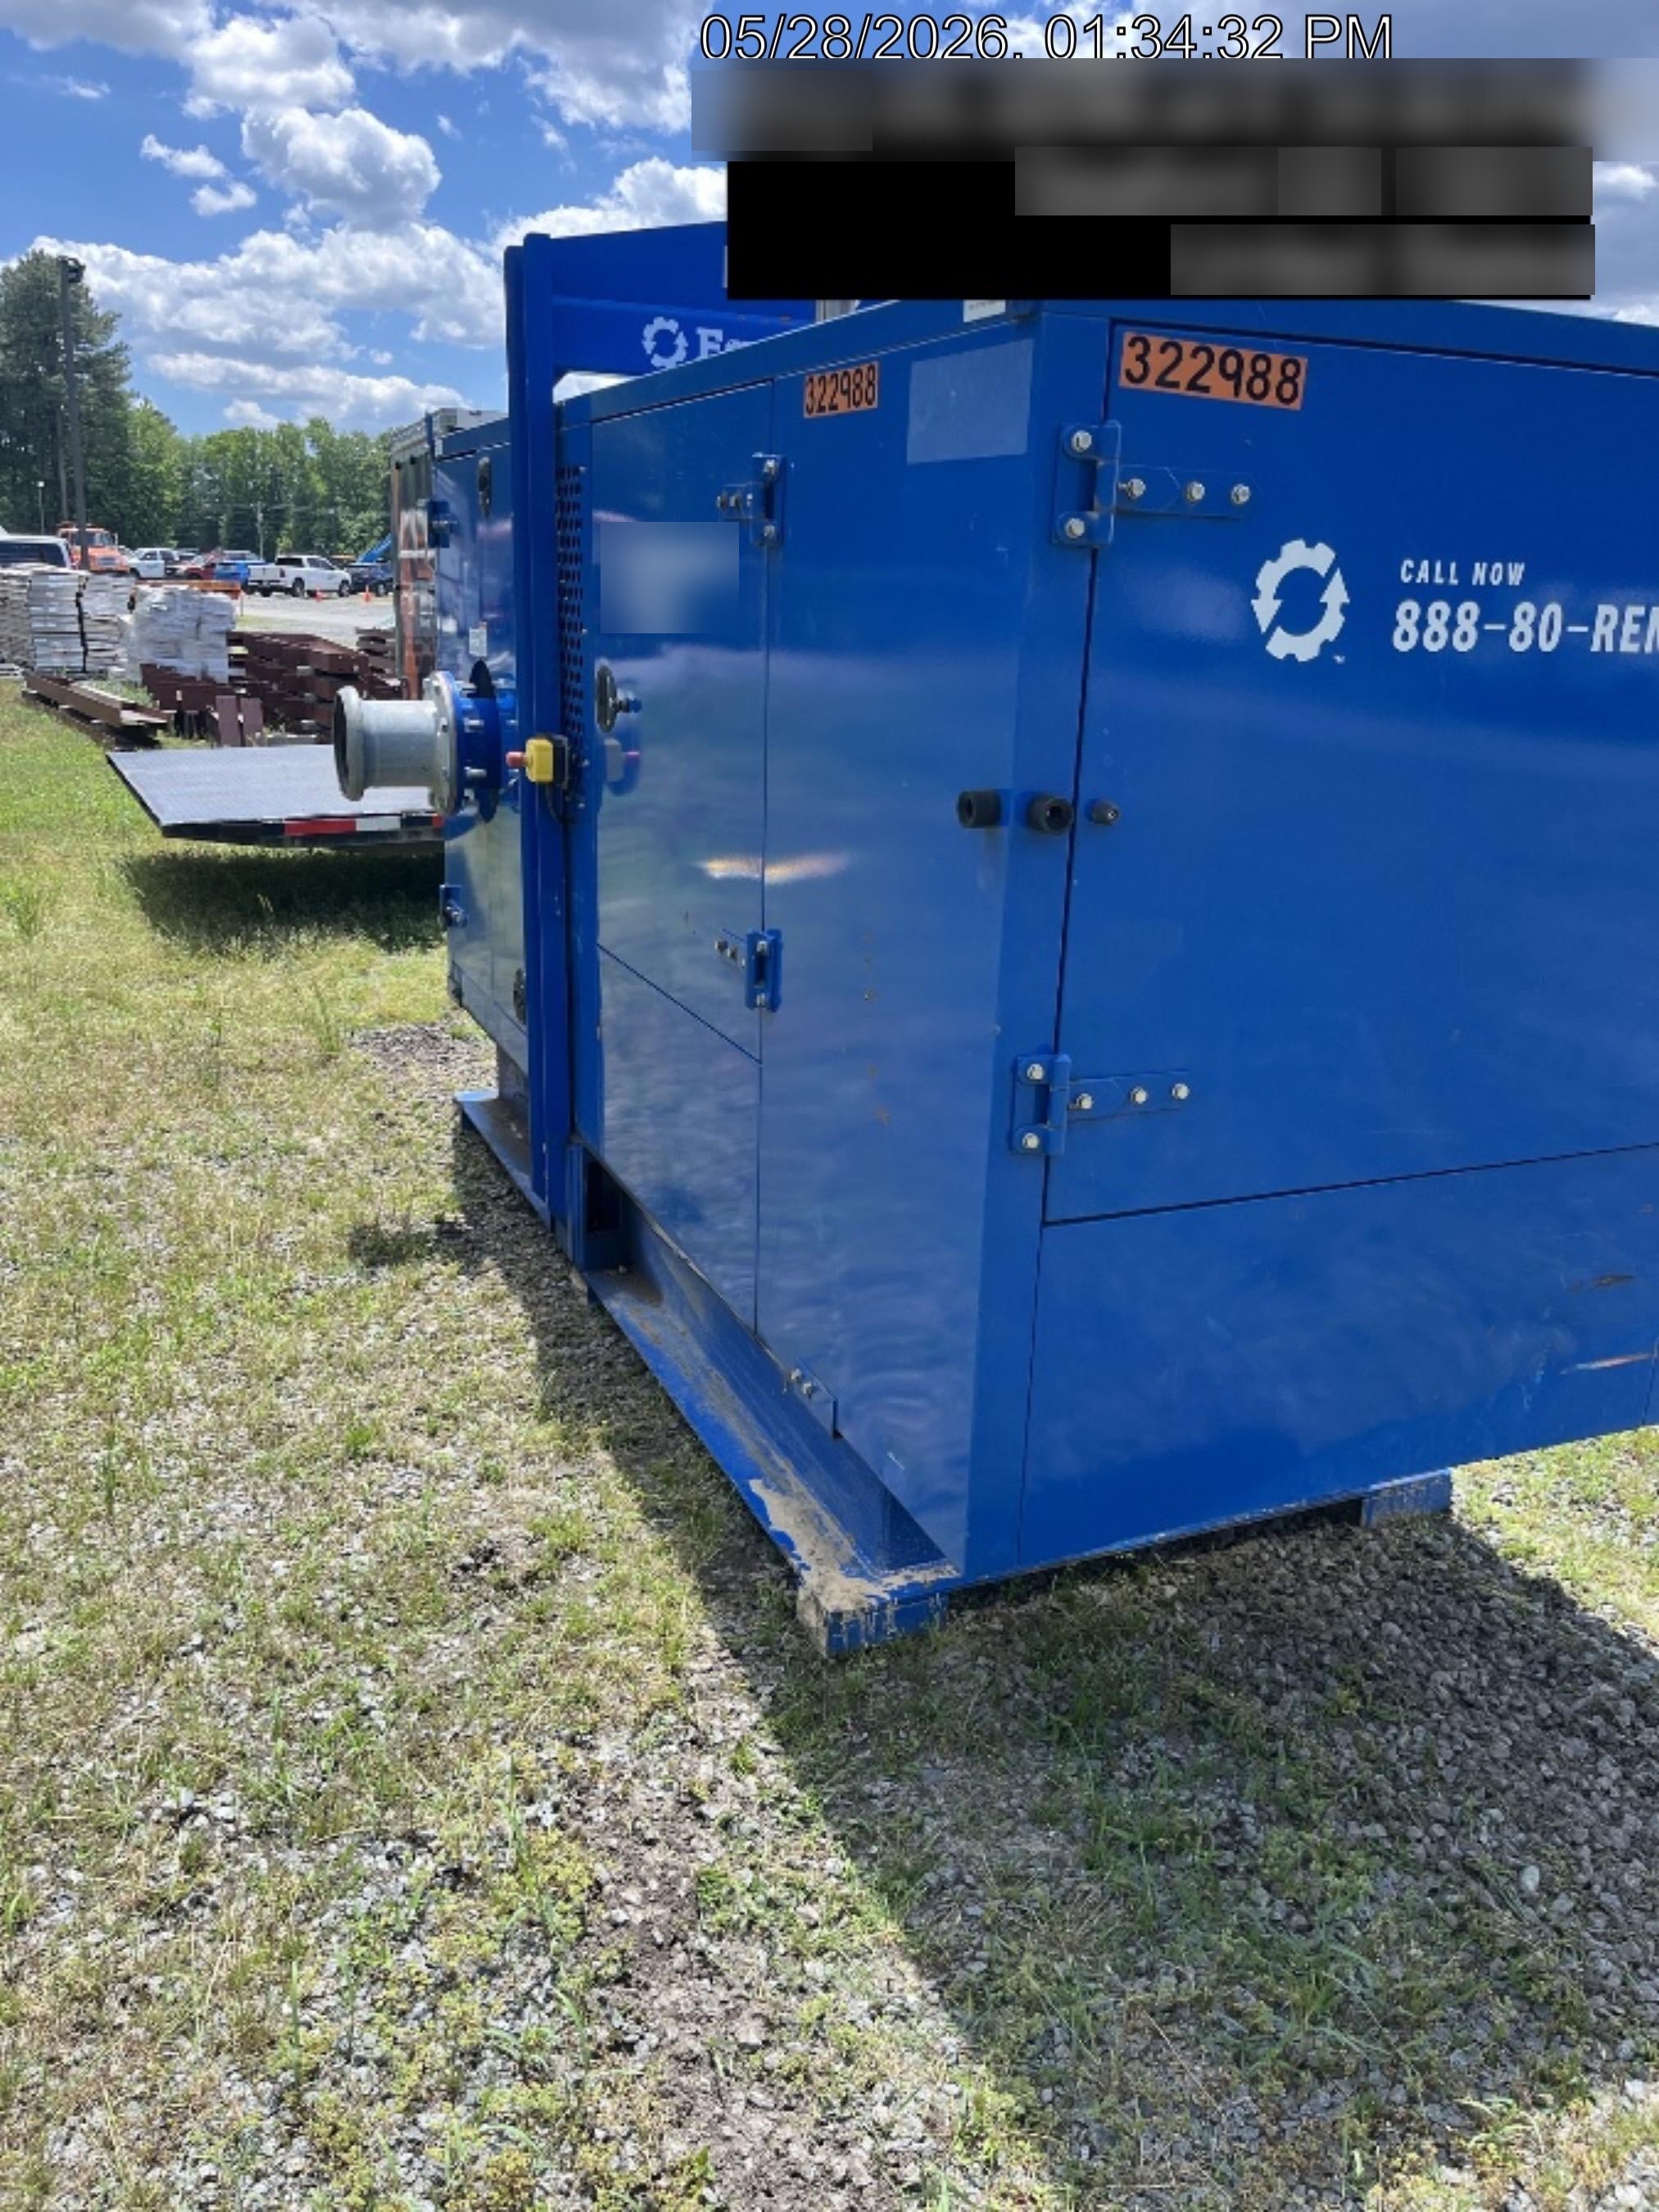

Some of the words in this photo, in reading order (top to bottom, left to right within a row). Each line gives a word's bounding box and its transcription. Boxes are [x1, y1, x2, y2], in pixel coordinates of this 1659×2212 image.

[806, 364, 876, 416] 322988
[1125, 336, 1302, 405] 322988
[1399, 559, 1459, 585] CALL
[1471, 561, 1525, 587] NOW
